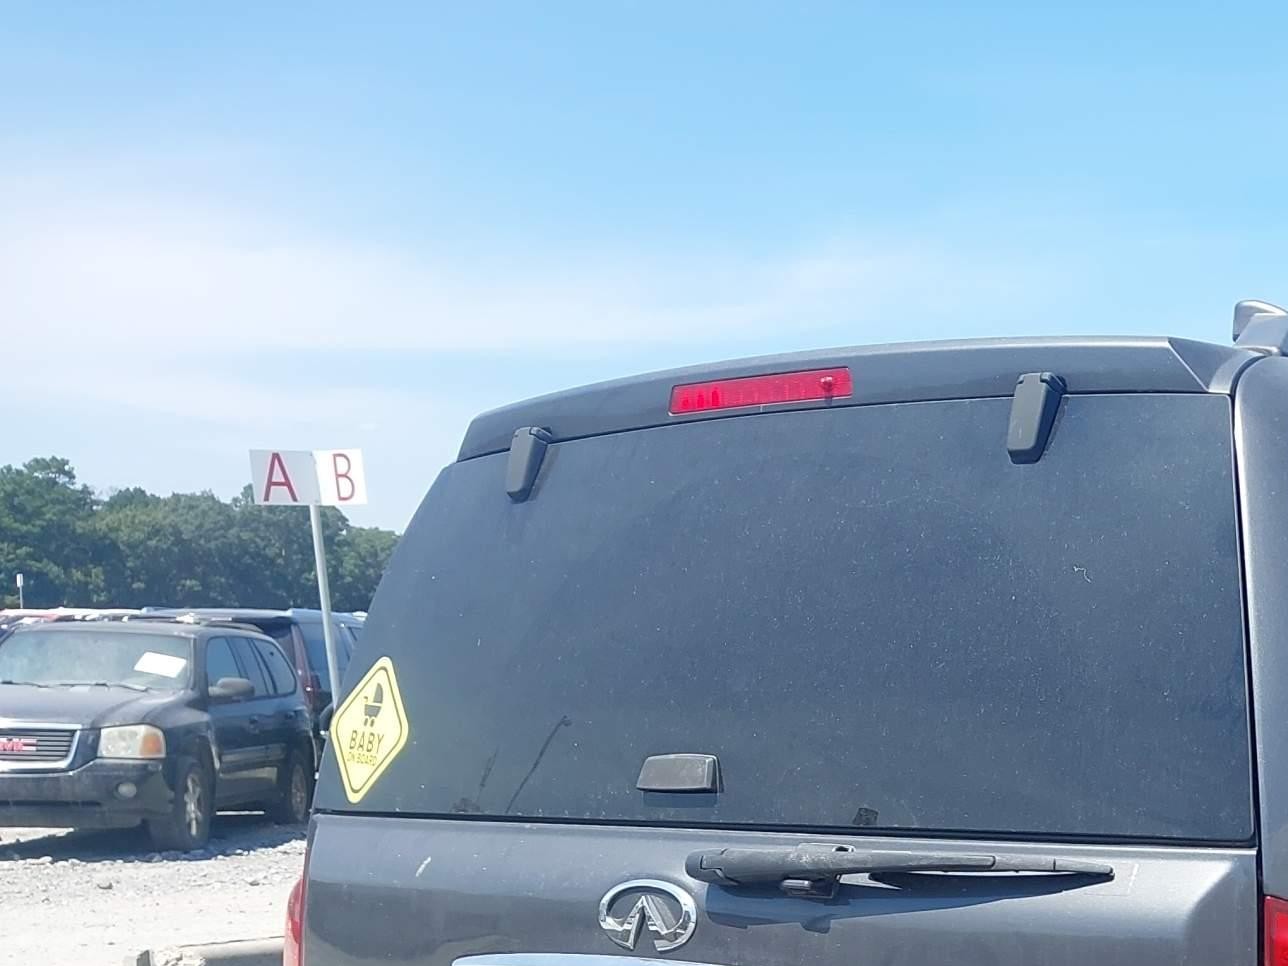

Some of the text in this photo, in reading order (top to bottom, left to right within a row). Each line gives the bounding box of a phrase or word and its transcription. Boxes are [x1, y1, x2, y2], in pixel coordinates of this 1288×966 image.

[263, 452, 298, 502] A
[332, 453, 355, 501] B
[349, 730, 384, 753] BABY
